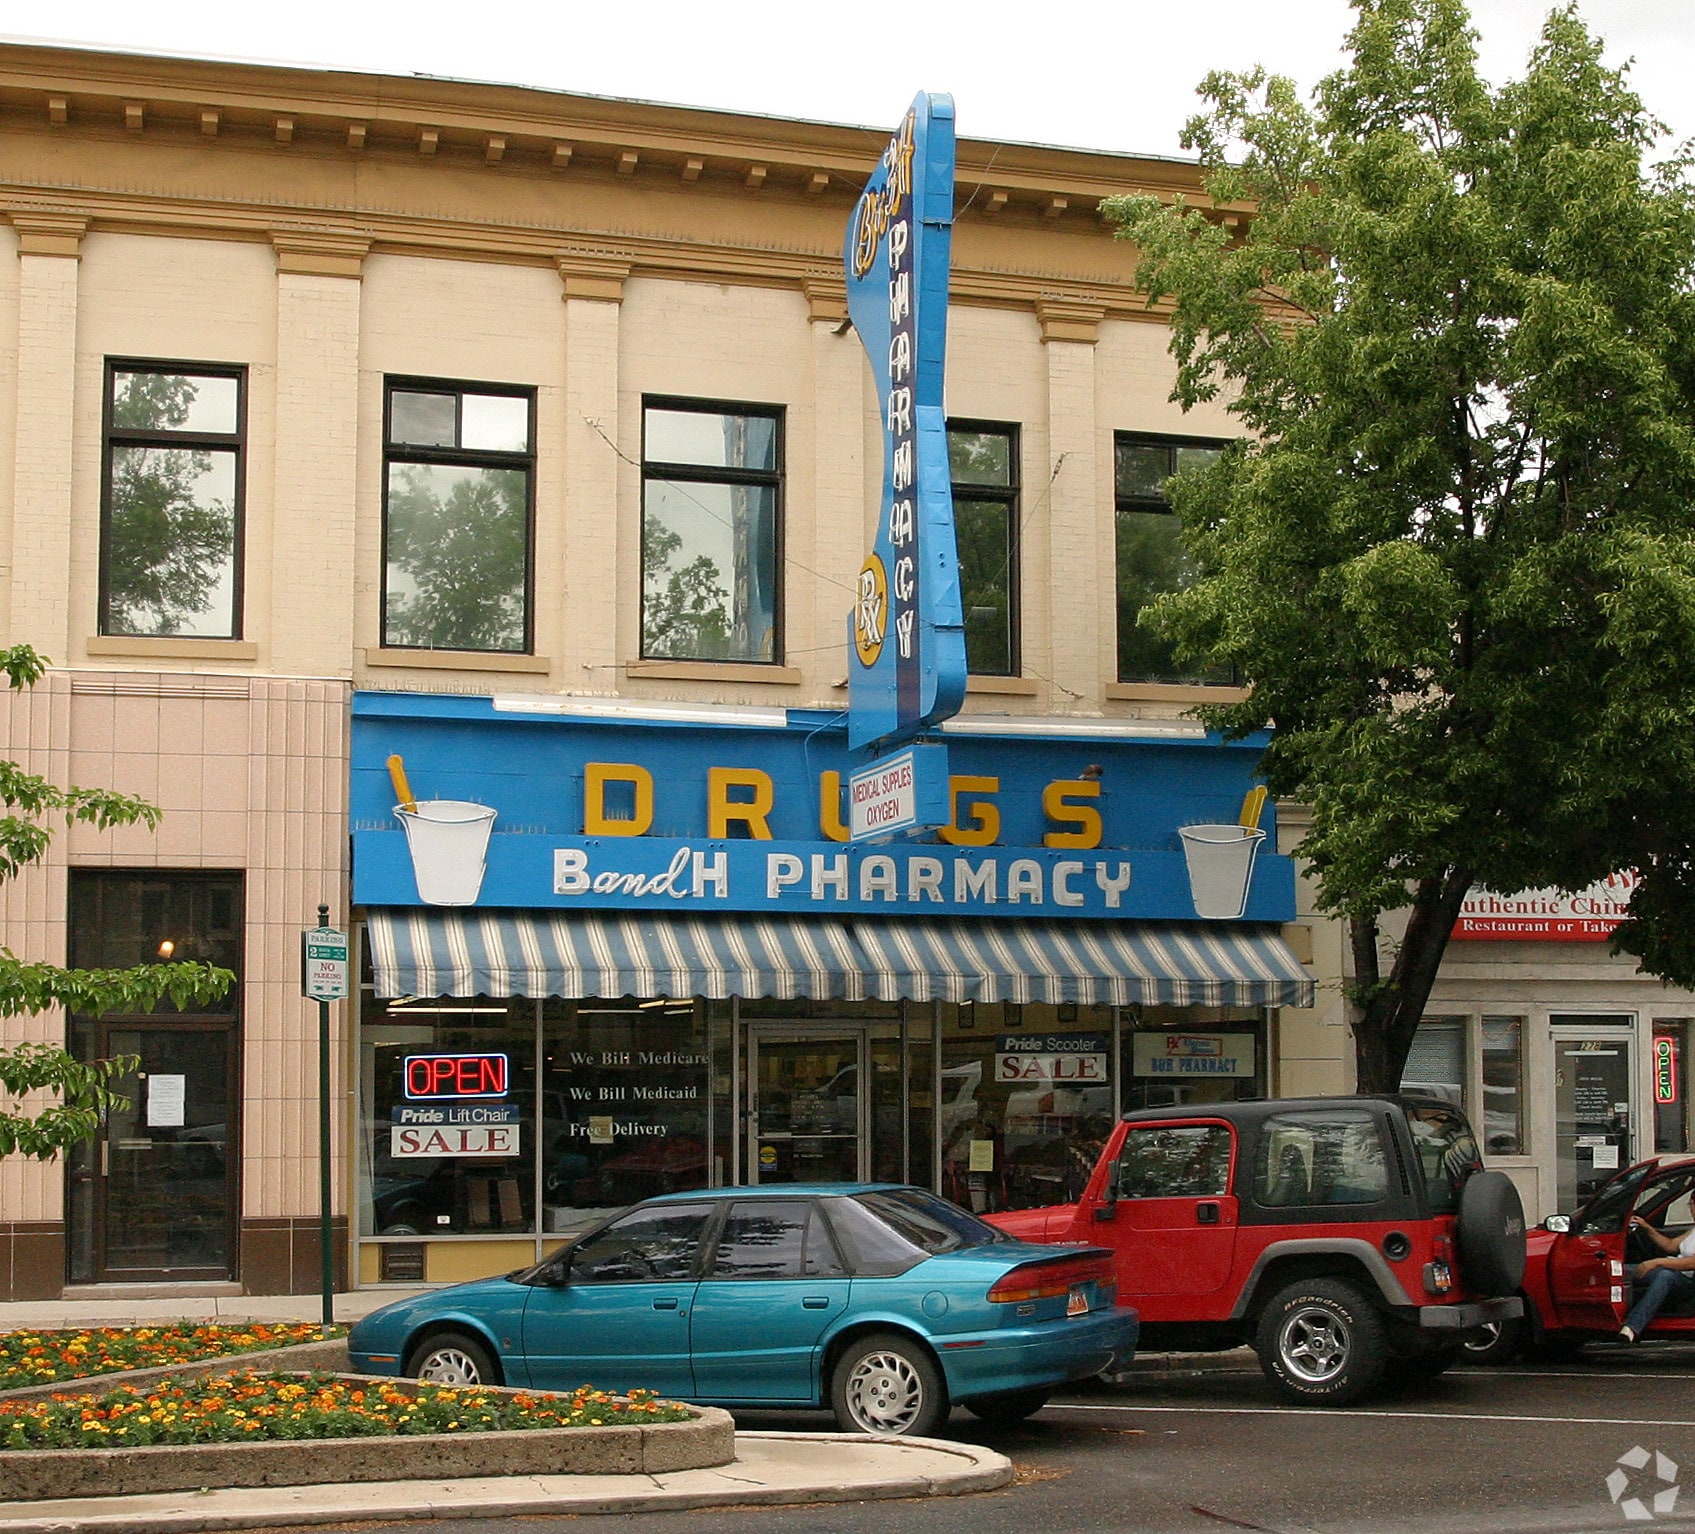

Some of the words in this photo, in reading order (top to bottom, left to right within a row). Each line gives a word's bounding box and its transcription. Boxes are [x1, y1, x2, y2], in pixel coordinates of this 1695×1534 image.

[888, 220, 914, 659] PHARMACY
[853, 778, 880, 803] MEDICAL
[882, 765, 912, 795] SUPPLIES
[866, 798, 899, 826] OXYGEN
[766, 852, 1131, 908] PHARMACY
[1462, 897, 1560, 915] uthentic
[1571, 898, 1628, 916] Chin
[1463, 919, 1550, 933] Restaurant
[1557, 922, 1574, 932] or
[321, 963, 335, 971] NO
[1005, 1037, 1043, 1051] Pride
[1047, 1037, 1097, 1051] Scooter
[570, 1052, 594, 1065] We
[602, 1051, 630, 1065] Bill
[639, 1051, 710, 1065] Medicare
[1002, 1056, 1099, 1079] SALE
[408, 1057, 504, 1095] OPEN
[570, 1087, 592, 1100] We
[600, 1086, 626, 1100] Bill
[633, 1086, 697, 1100] Medicaid
[401, 1108, 444, 1123] Pride
[570, 1123, 602, 1137] Free
[609, 1122, 669, 1137] Delivery
[399, 1127, 512, 1154] SALE
